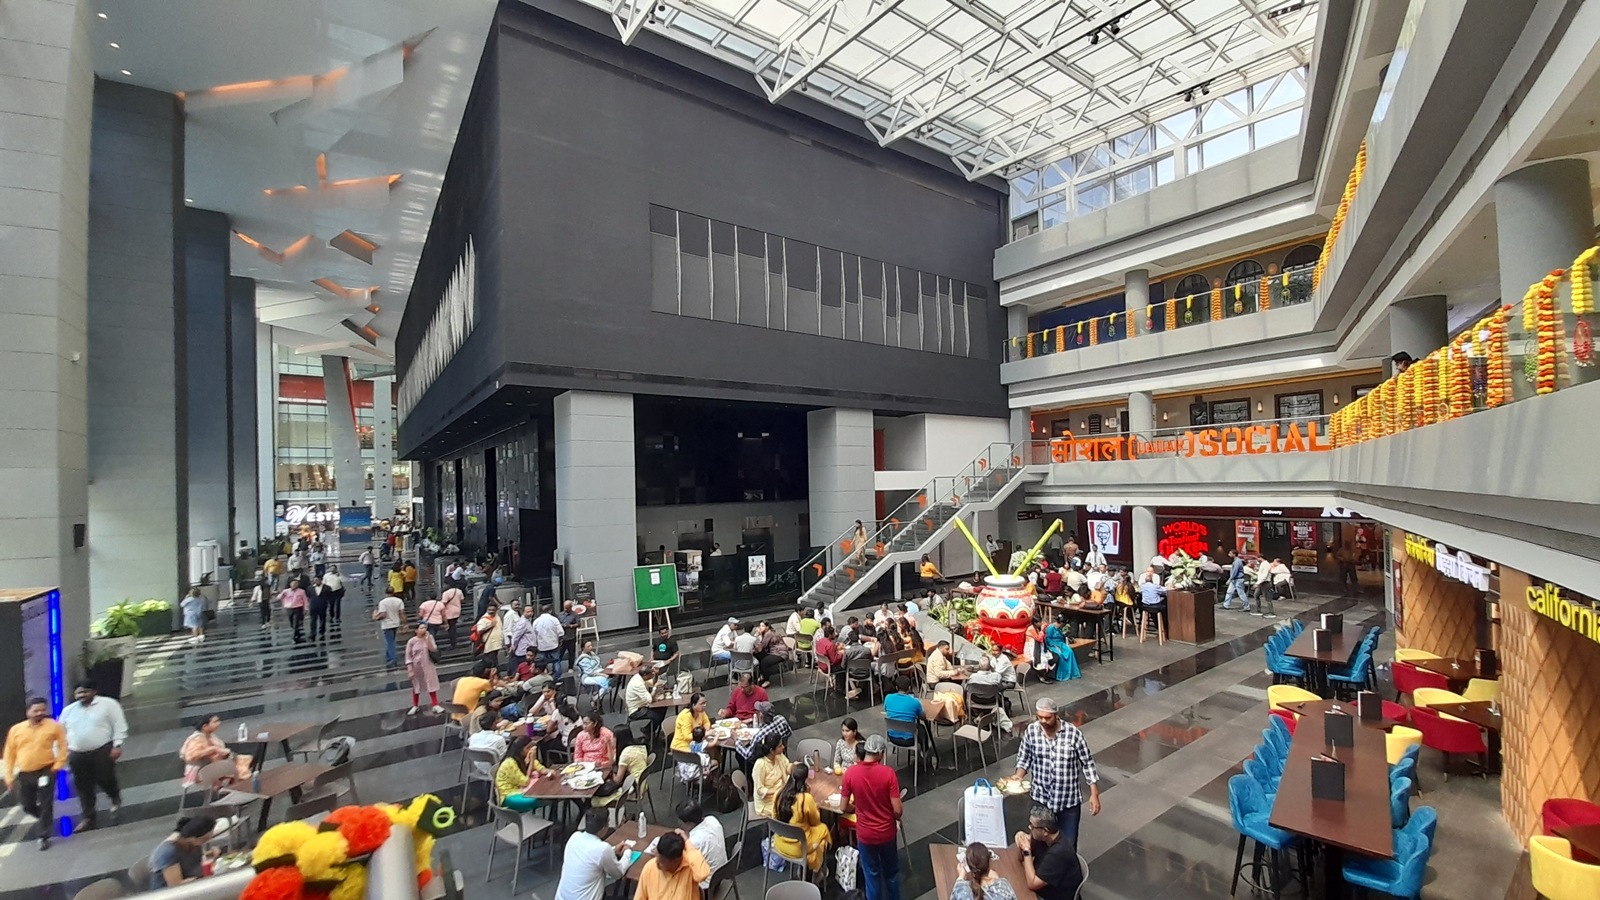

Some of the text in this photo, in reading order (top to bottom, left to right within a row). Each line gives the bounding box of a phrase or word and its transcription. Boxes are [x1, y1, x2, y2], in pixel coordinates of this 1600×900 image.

[1050, 430, 1125, 463] सोशल
[1199, 421, 1331, 457] SOCIAL
[1161, 520, 1208, 536] WORLD'S
